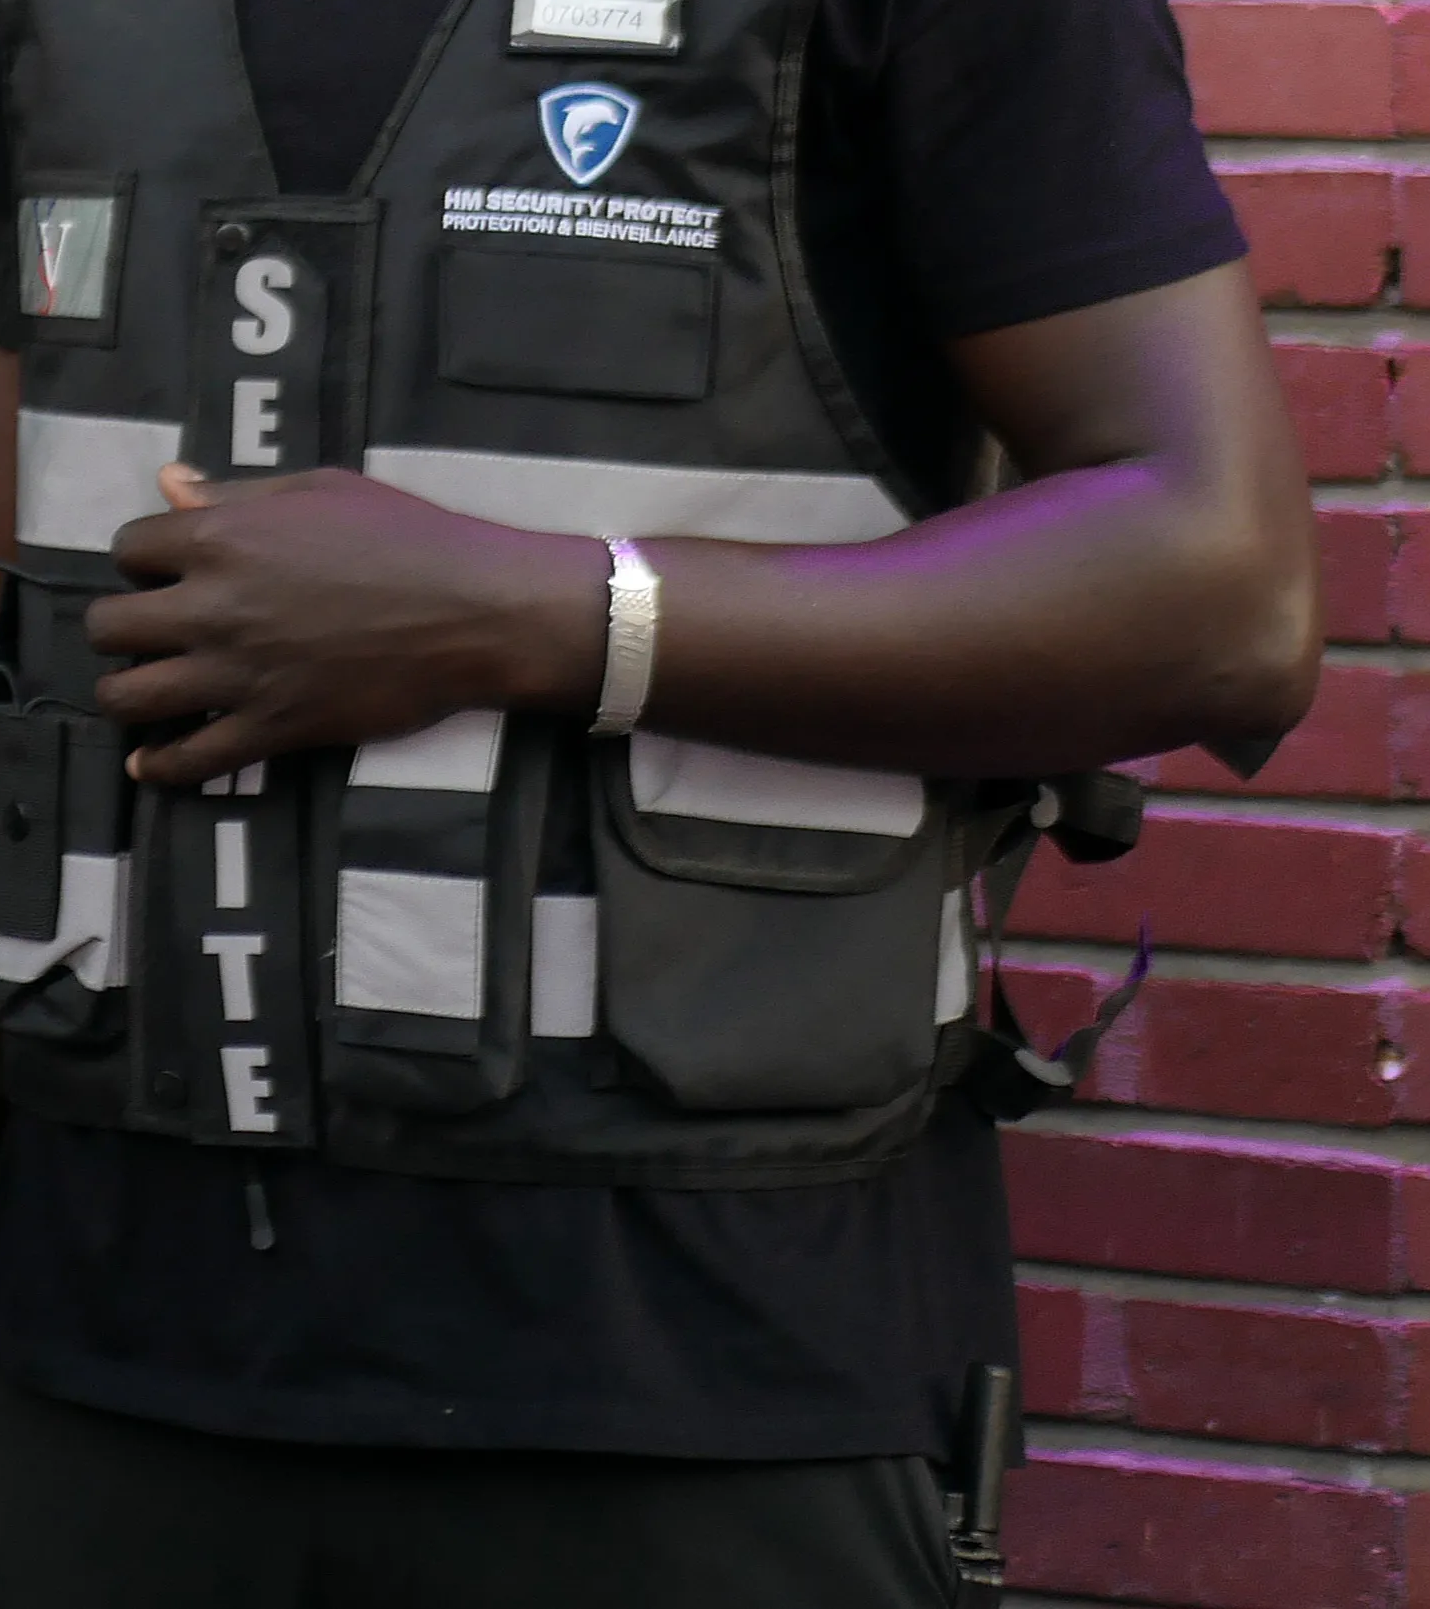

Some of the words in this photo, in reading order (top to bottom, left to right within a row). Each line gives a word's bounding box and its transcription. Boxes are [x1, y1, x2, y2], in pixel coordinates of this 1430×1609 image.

[444, 190, 484, 210] HM
[486, 190, 607, 218] SECURITY
[607, 197, 722, 228] PROTECT
[443, 212, 554, 234] PROTECTION
[557, 219, 572, 236] &
[574, 220, 720, 249] BIENVEILLANCE
[200, 256, 296, 1134] SEITE
